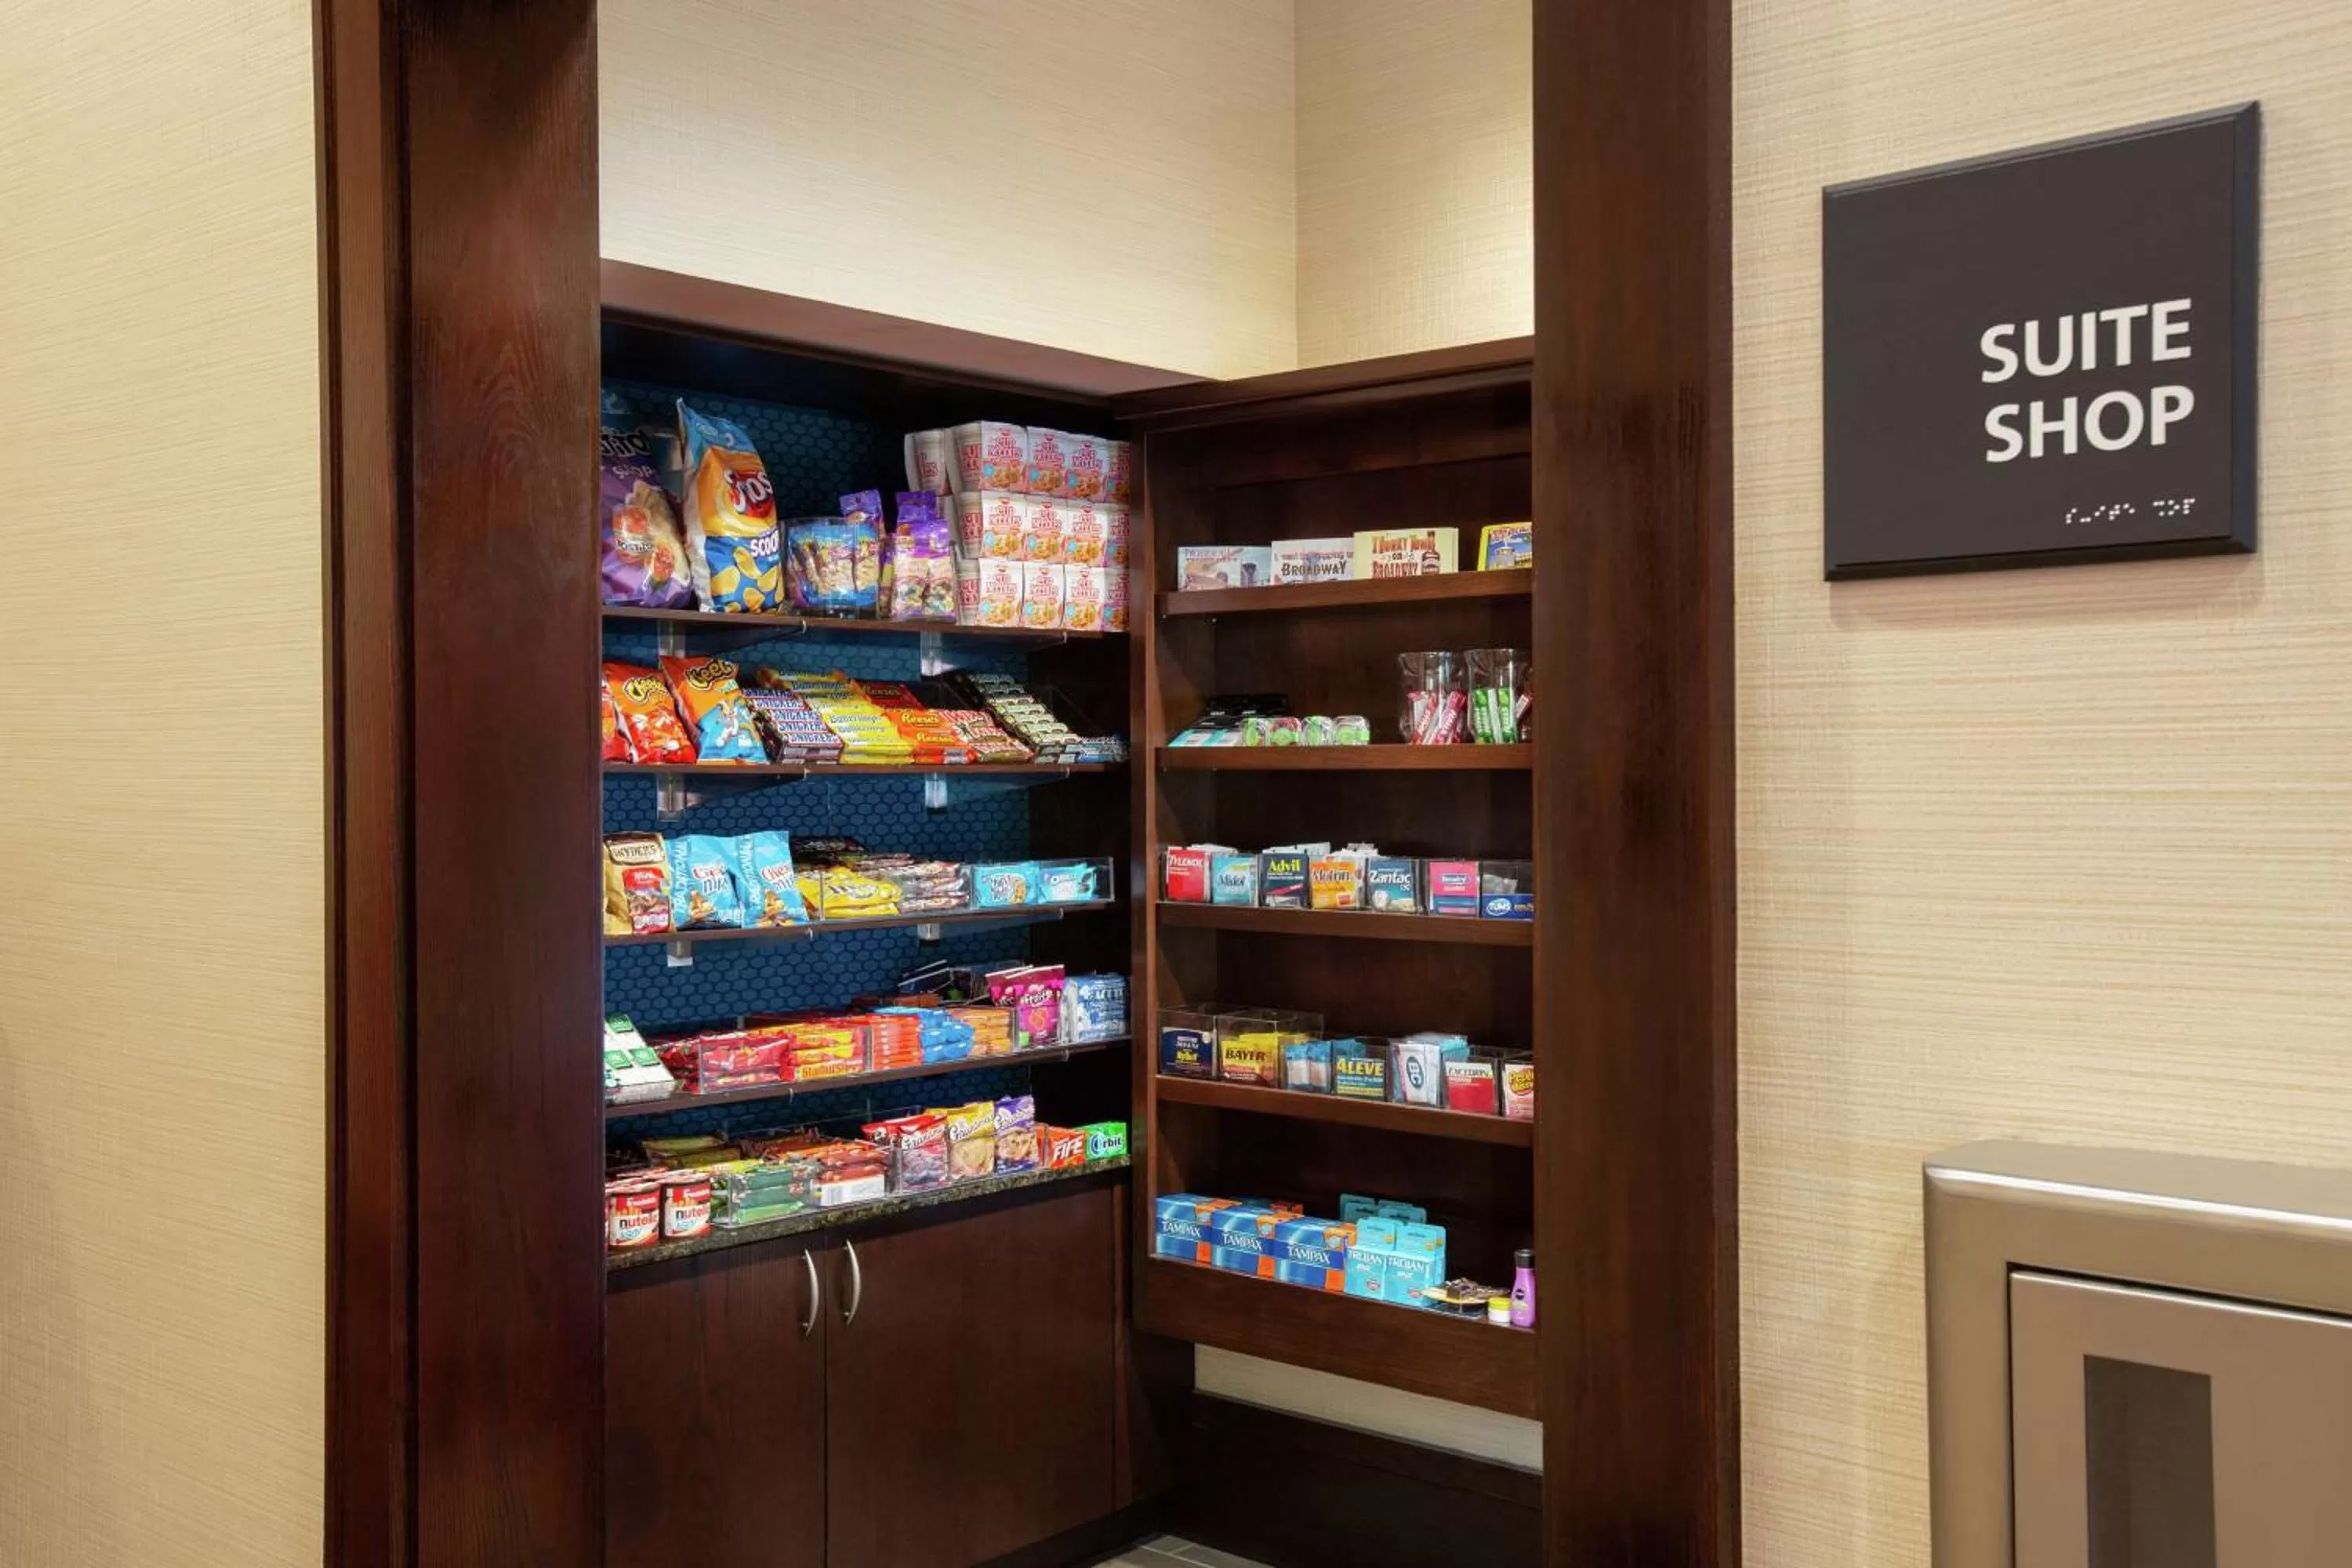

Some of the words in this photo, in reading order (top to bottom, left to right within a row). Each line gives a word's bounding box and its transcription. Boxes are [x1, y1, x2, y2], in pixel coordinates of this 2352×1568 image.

[1980, 298, 2191, 383] SUITE
[1984, 385, 2194, 463] SHOP
[1281, 561, 1348, 576] BROADWAY
[1269, 858, 1301, 873] Advil
[1370, 869, 1410, 884] Zantac
[1225, 1048, 1266, 1062] BAYER
[1336, 1056, 1384, 1076] ALEVE
[1091, 1132, 1122, 1156] Orbit
[1162, 1221, 1202, 1239] TAMPAX
[1223, 1233, 1263, 1252] TAMPAX
[1287, 1245, 1331, 1265] TAMPAX
